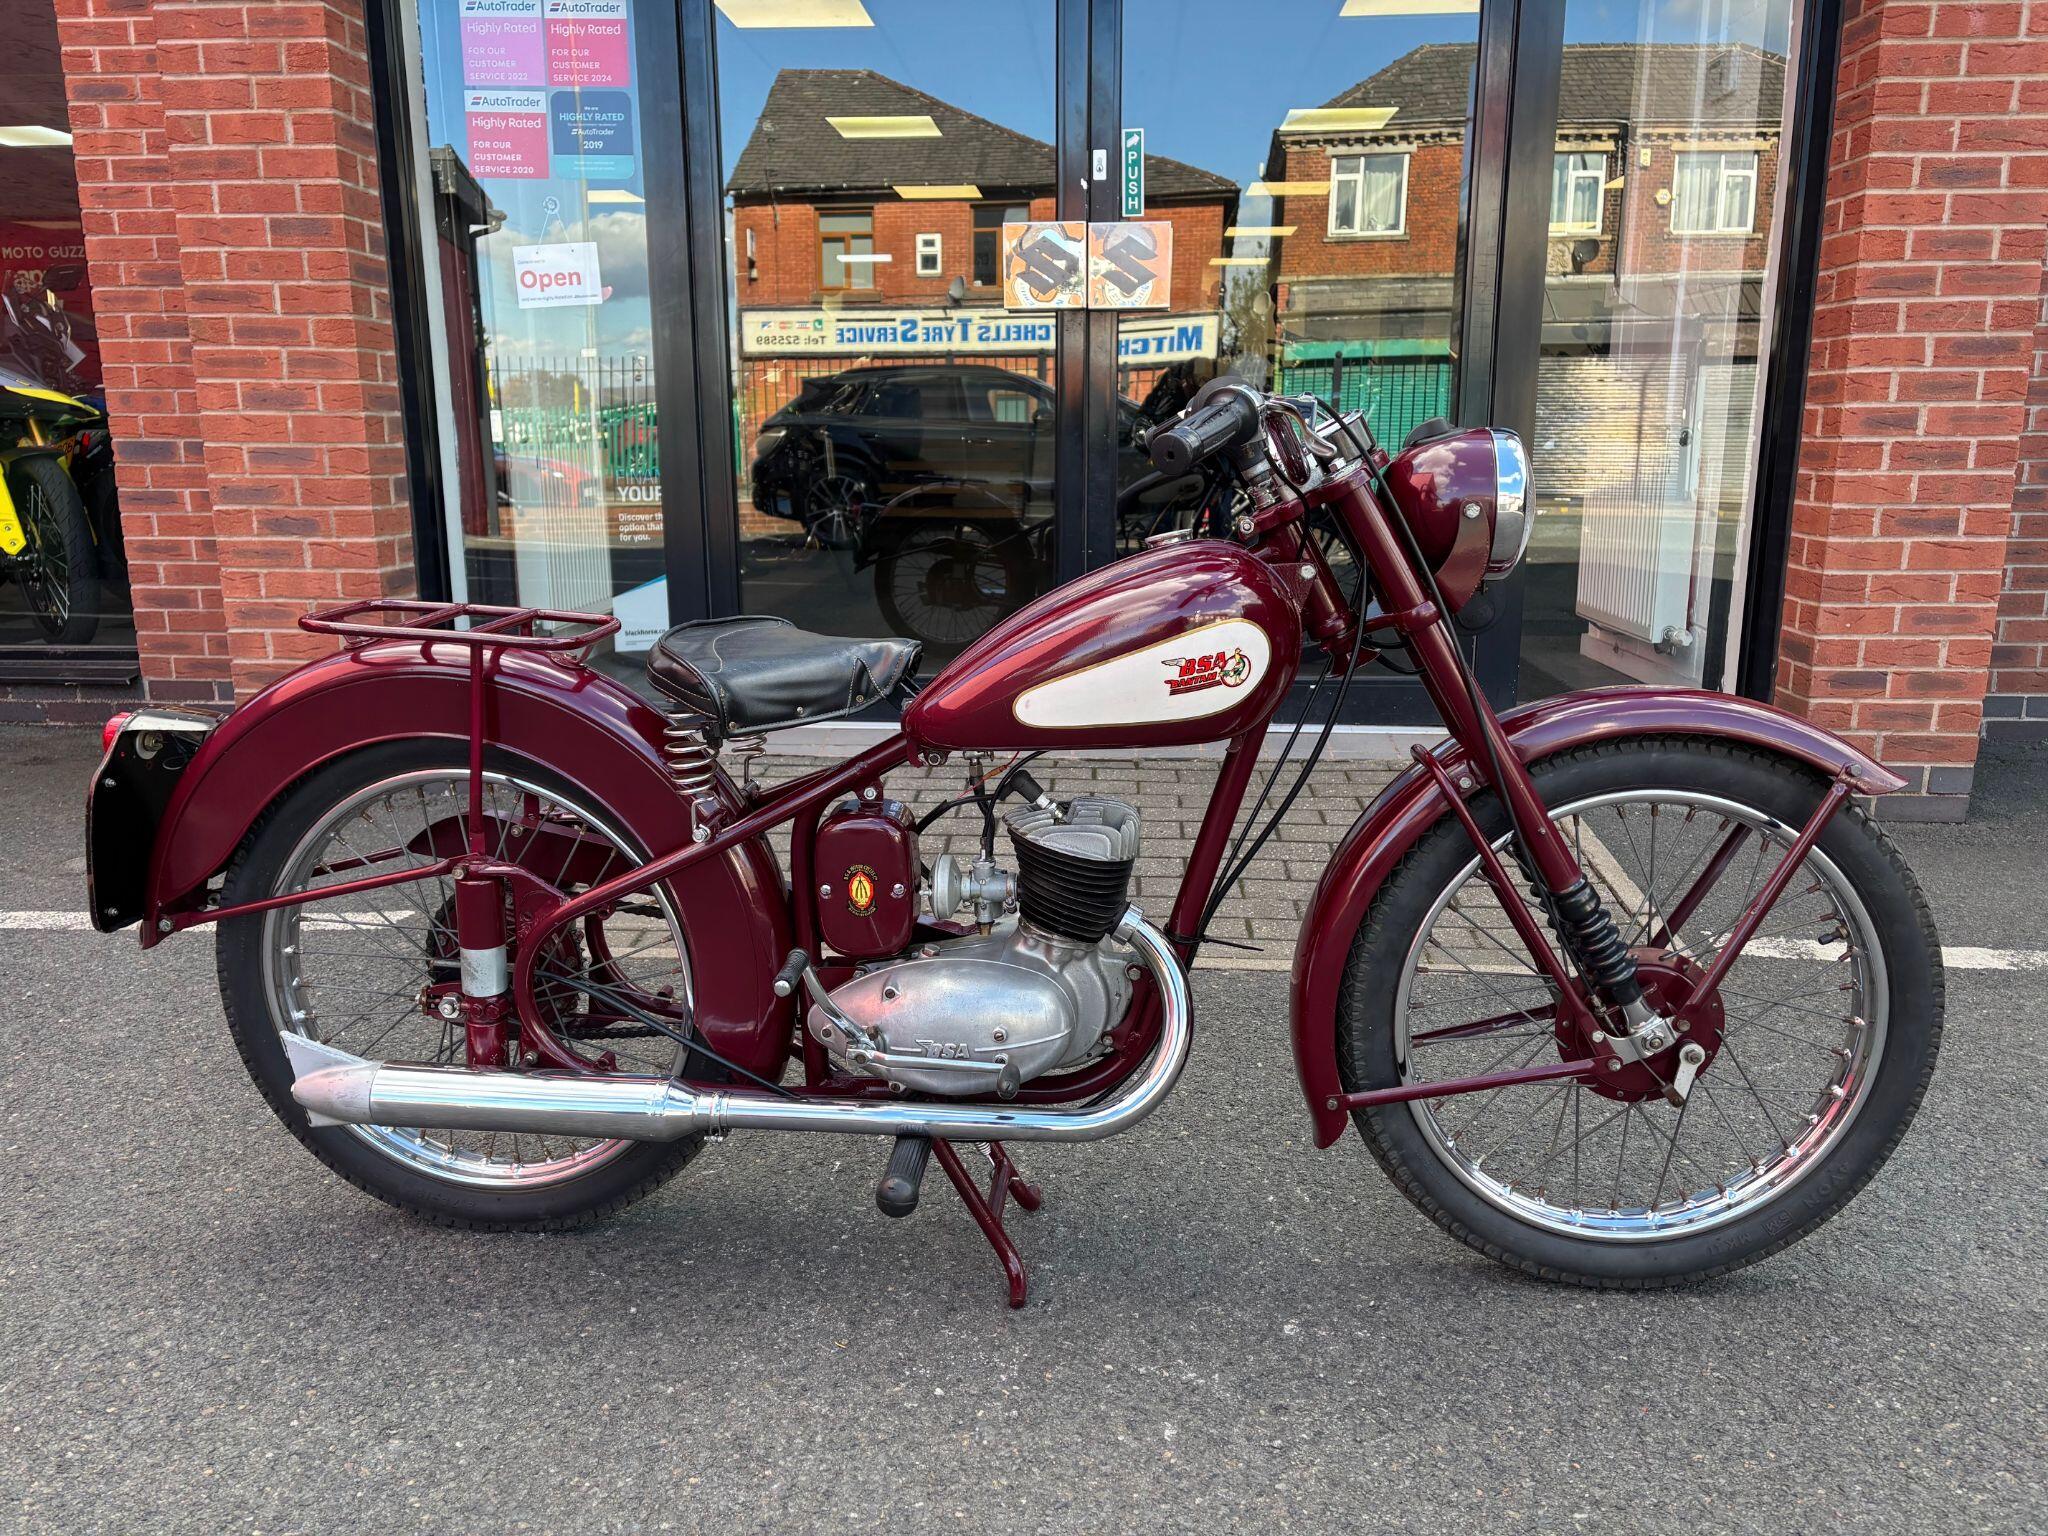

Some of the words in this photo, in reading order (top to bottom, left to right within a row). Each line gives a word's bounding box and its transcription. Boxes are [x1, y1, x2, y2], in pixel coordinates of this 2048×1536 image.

[477, 1, 536, 11] AutoTrader
[560, 2, 621, 13] AutoTrader
[467, 22, 501, 36] Highly
[504, 22, 537, 33] Rated
[550, 24, 586, 37] Highly
[588, 24, 621, 35] Rated
[468, 47, 485, 55] FOR
[487, 47, 506, 55] OUR
[551, 48, 569, 56] FOR
[571, 48, 590, 57] OUR
[469, 59, 517, 68] CUSTOMER
[552, 61, 601, 69] CUSTOMER
[469, 72, 506, 81] SERVICE
[507, 72, 528, 81] 2022
[552, 74, 589, 82] SERVICE
[591, 74, 612, 82] 2024
[481, 96, 541, 107] AutoTrader
[560, 112, 593, 121] HIGHLY
[594, 112, 625, 121] RATED
[472, 116, 507, 130] Highly
[508, 117, 542, 129] Rated
[577, 128, 615, 136] AutoTrader
[473, 141, 491, 149] FOR
[492, 141, 512, 149] OUR
[583, 140, 604, 149] 2019
[474, 153, 522, 161] CUSTOMER
[474, 165, 511, 174] SERVICE
[512, 166, 534, 174] 2020
[1128, 151, 1138, 210] PUSH
[1, 246, 44, 259] MOTO
[520, 270, 582, 292] Open
[618, 513, 654, 522] Discover
[619, 524, 645, 533] option
[646, 523, 664, 532] that
[620, 533, 632, 542] for
[633, 533, 651, 543] you.
[1179, 652, 1226, 677] BSA
[926, 1042, 970, 1059] BSA
